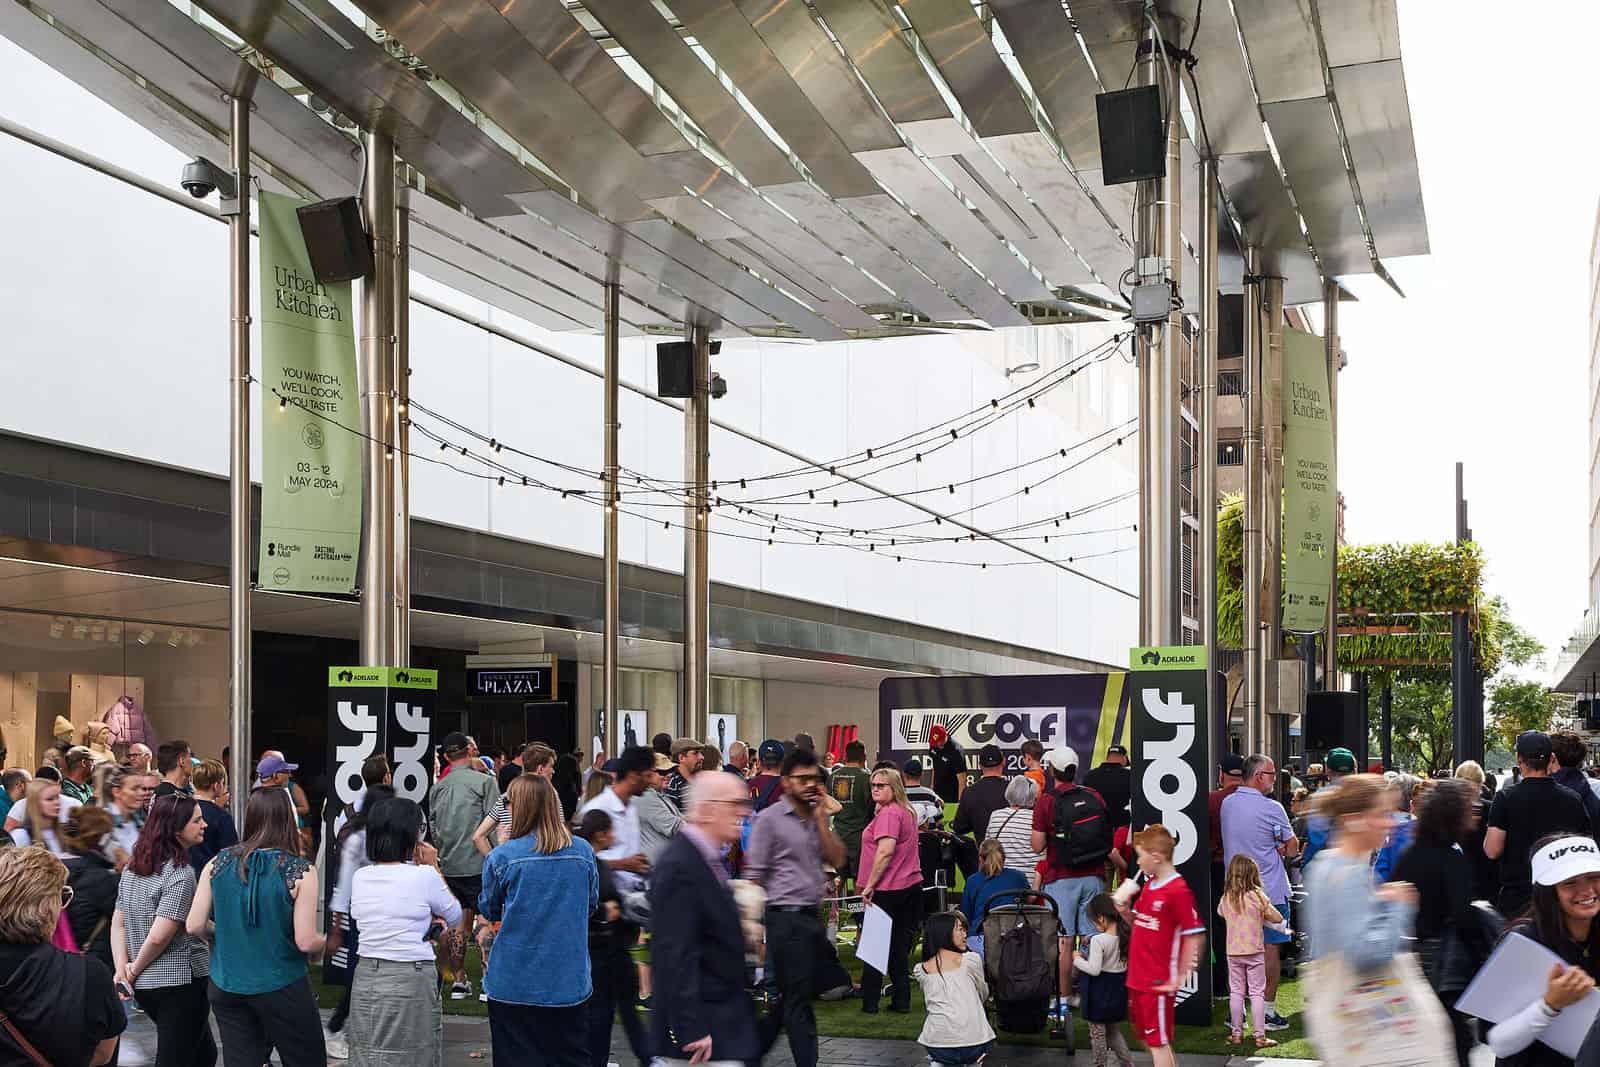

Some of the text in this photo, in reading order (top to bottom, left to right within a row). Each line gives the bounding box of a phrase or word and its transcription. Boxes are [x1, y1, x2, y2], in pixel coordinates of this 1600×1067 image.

[274, 265, 328, 296] Urban
[275, 288, 343, 322] Kitchen
[282, 367, 303, 379] YOU
[281, 380, 310, 394] WE'LL
[1291, 382, 1321, 402] Urban
[309, 400, 337, 413] TASTE
[1292, 400, 1329, 421] Kitchen
[297, 462, 310, 473] 03
[320, 464, 330, 475] 12
[289, 475, 338, 489] MAY 2024
[1161, 655, 1195, 664] ADELAIDE
[485, 680, 534, 694] PLAZA
[967, 712, 1058, 744] GOLF
